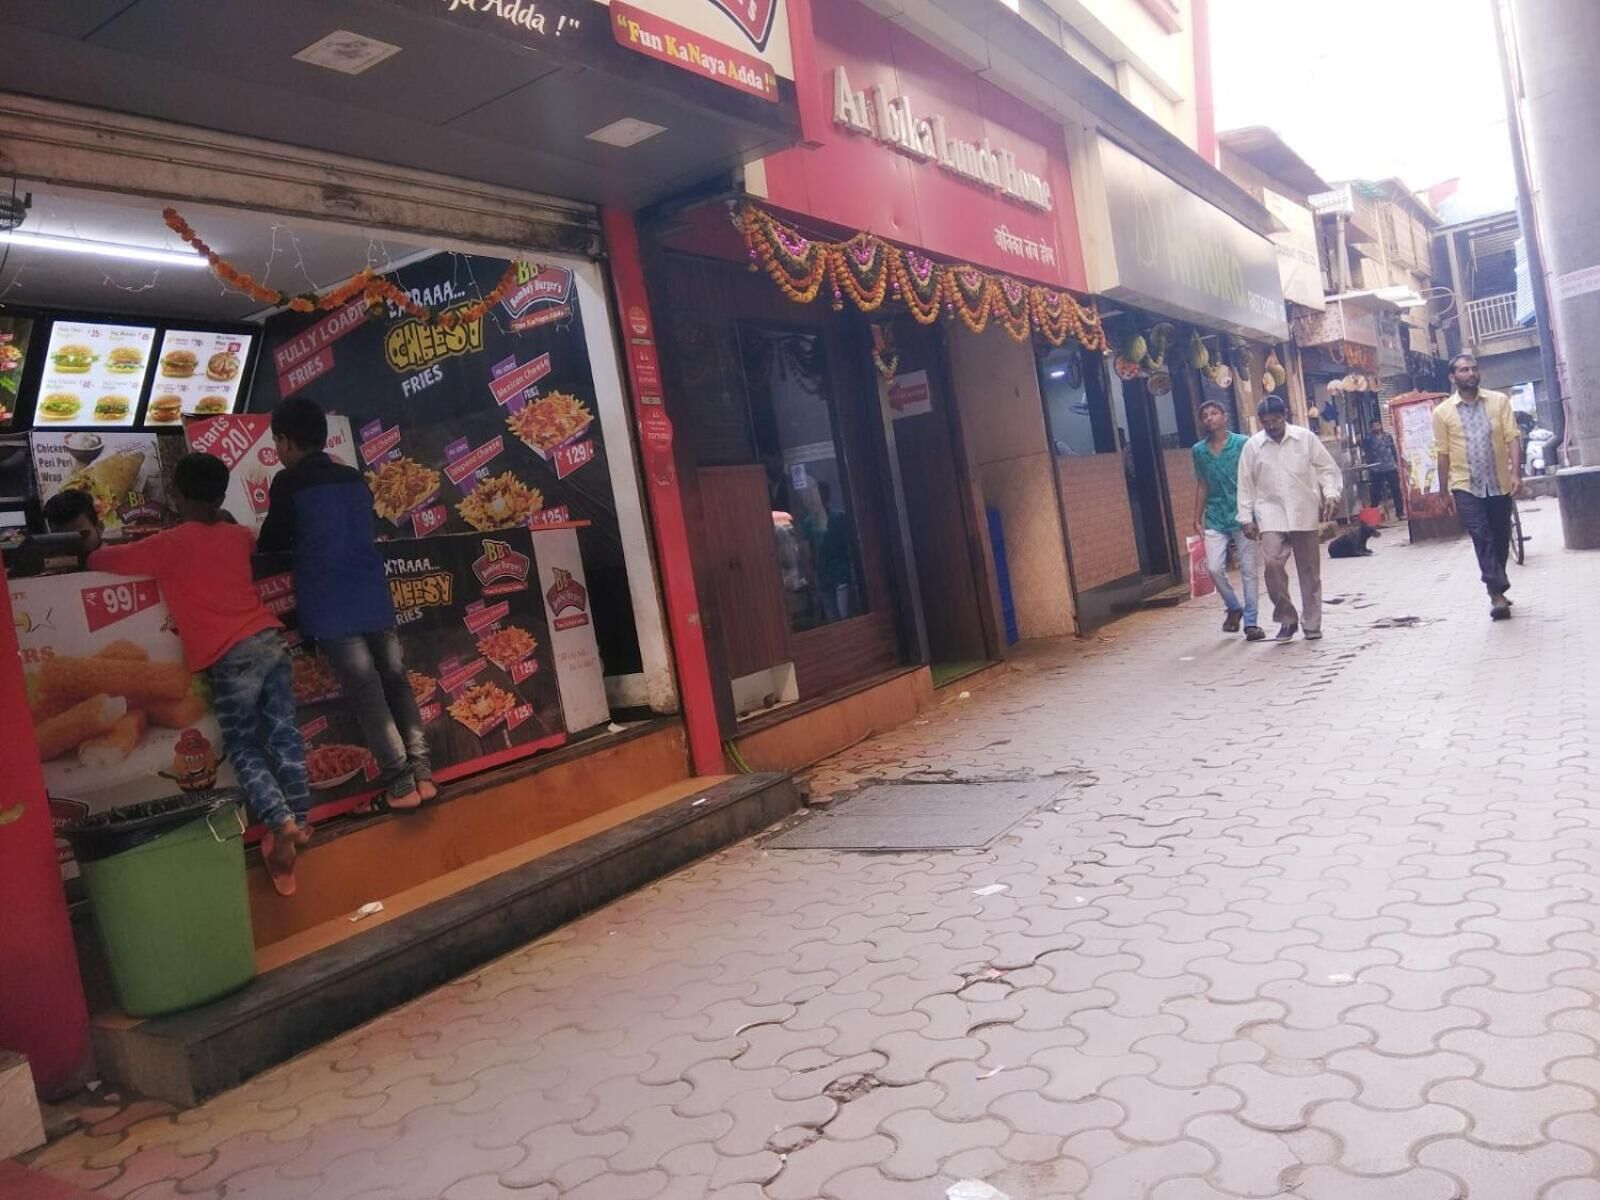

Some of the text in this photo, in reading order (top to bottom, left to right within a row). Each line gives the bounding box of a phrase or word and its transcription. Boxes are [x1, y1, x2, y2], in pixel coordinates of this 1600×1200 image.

[728, 61, 763, 92] Adda
[1001, 147, 1052, 212] Home
[277, 329, 318, 369] FULLY
[287, 356, 325, 389] FRIES
[402, 365, 443, 398] FRIES
[36, 443, 67, 455] Chicken
[191, 416, 230, 454] Starts
[221, 418, 256, 460] 20/-
[39, 457, 73, 468] Peri Peri
[565, 443, 594, 465] 129/-
[41, 471, 63, 483] Wrap
[383, 558, 440, 576] XTRAAA...
[102, 583, 146, 614] 99/-
[389, 573, 452, 611] HEESY
[395, 606, 423, 625] RIES
